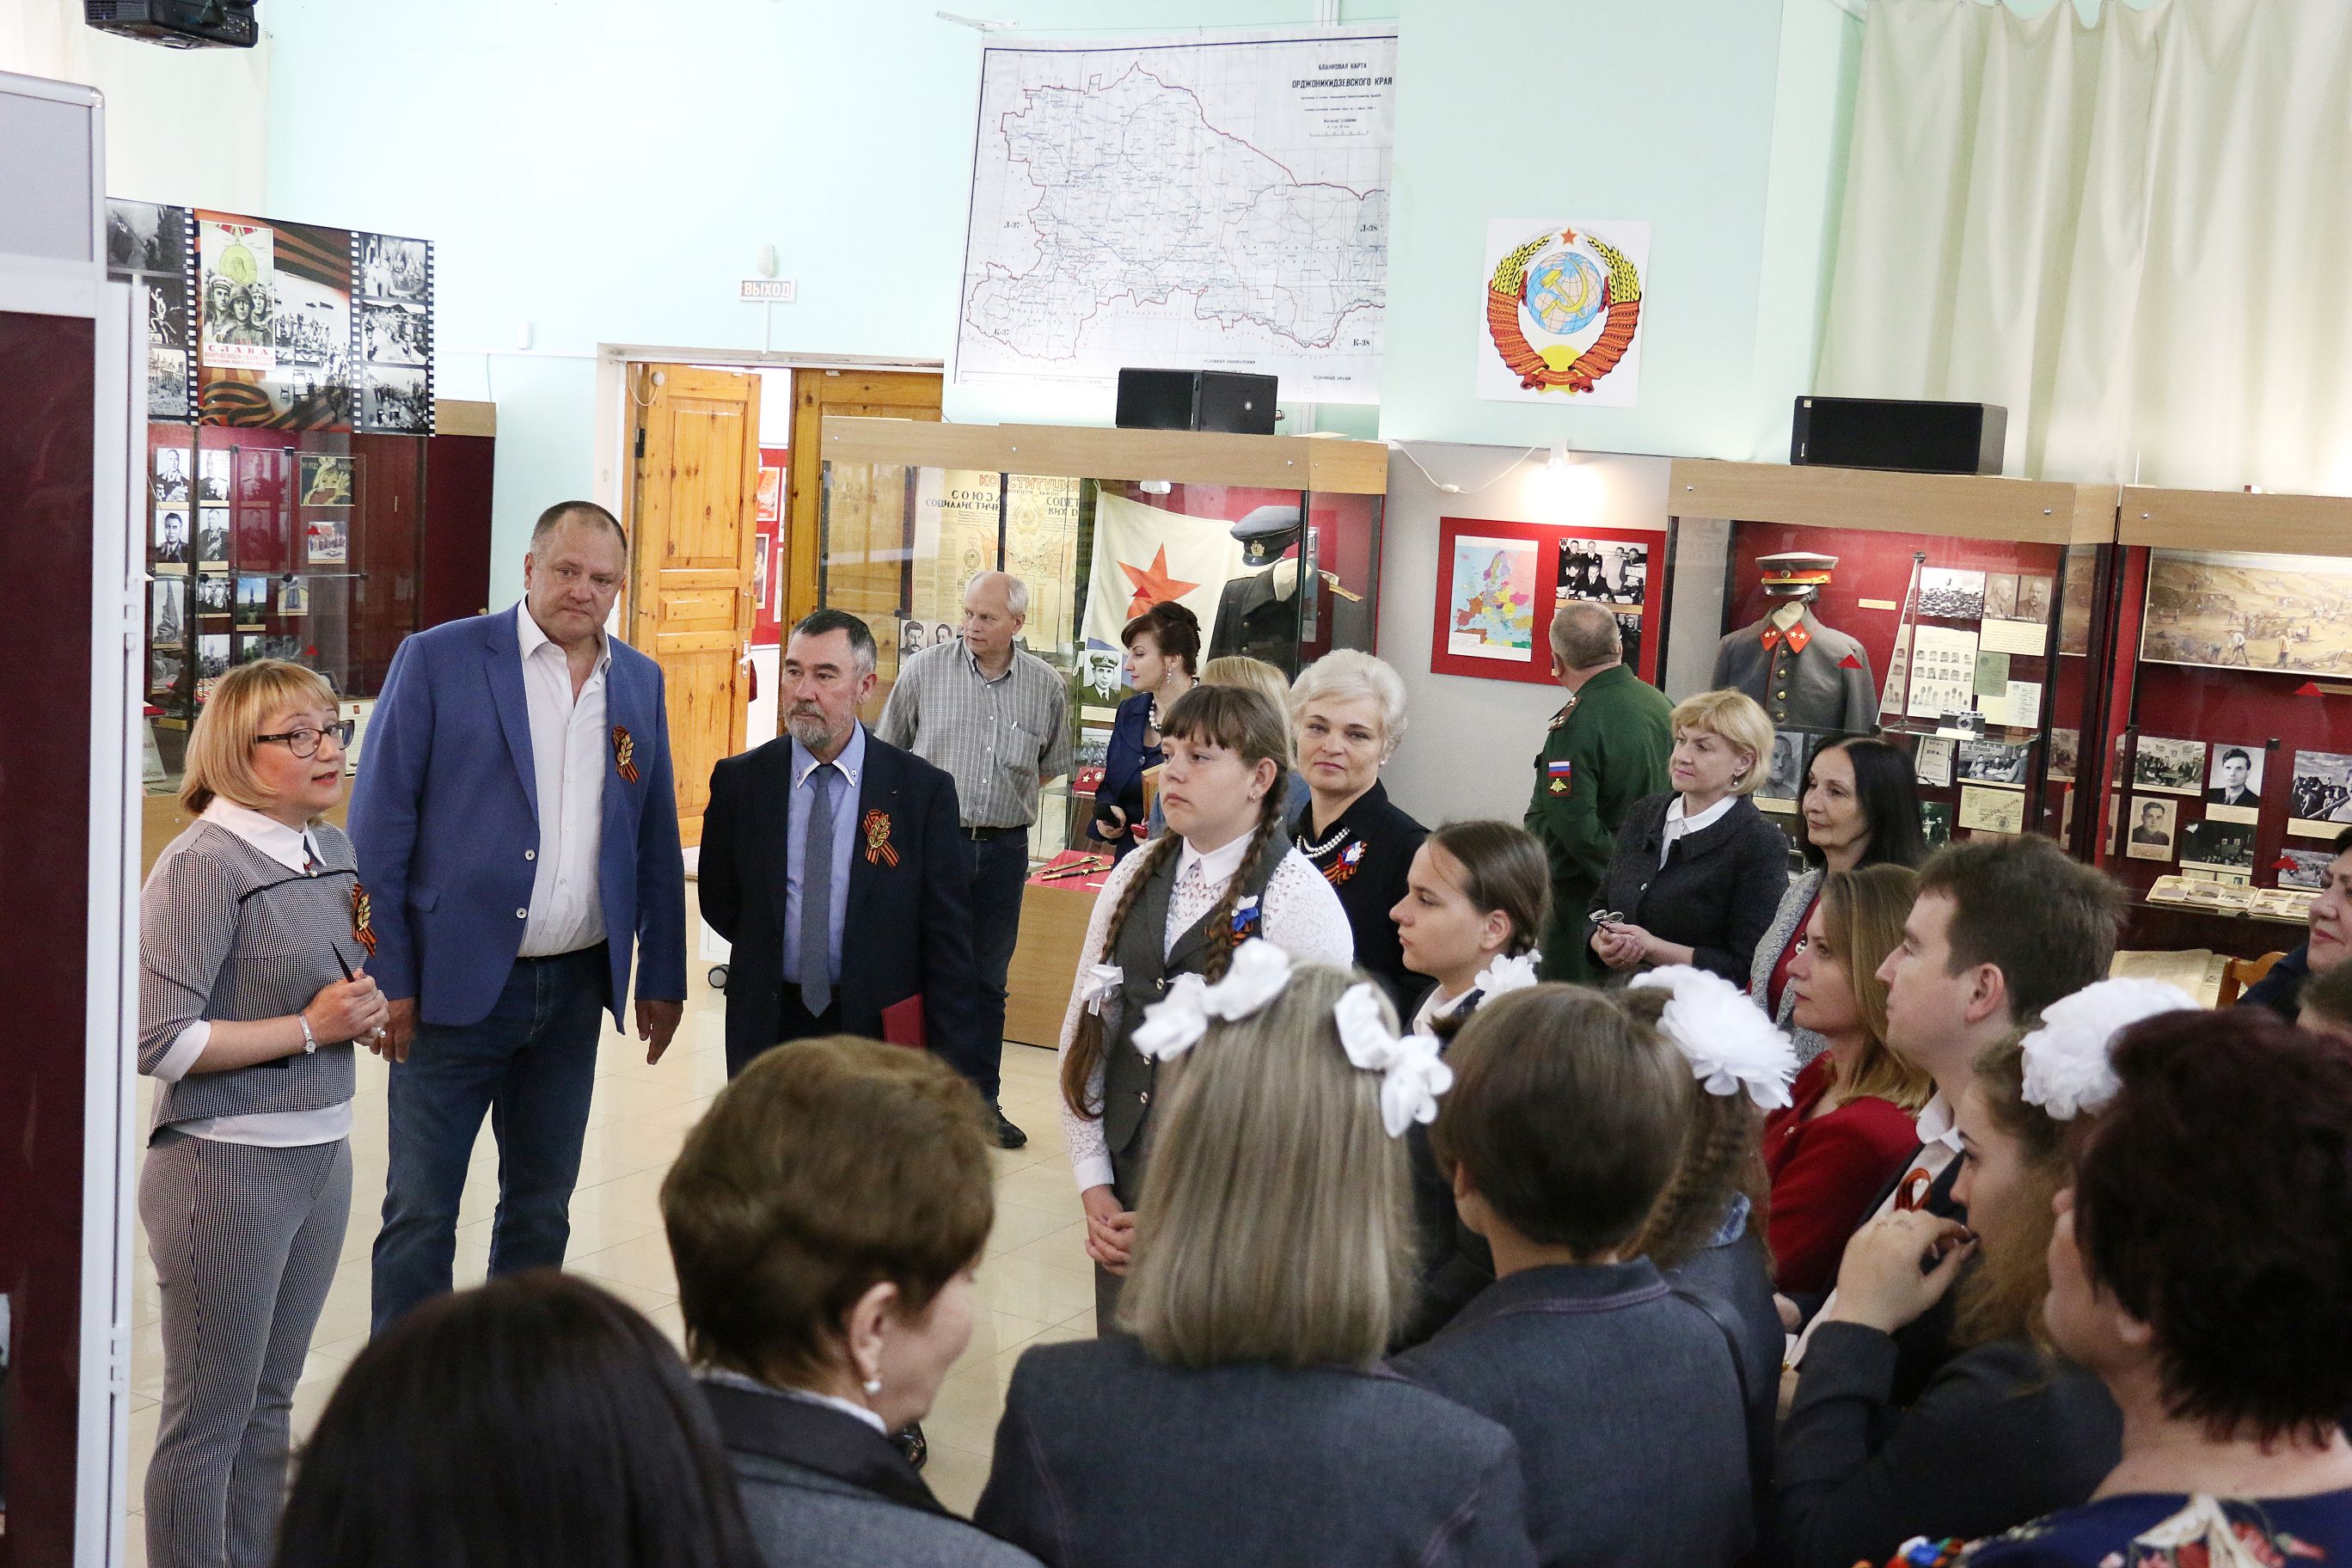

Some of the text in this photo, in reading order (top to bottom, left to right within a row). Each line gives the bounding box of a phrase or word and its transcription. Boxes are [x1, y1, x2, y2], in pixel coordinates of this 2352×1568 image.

[1291, 77, 1393, 89] ОРДЖОНИКИДЗЕВСКОГО КРАЯ
[744, 281, 791, 297] ВЫХОД
